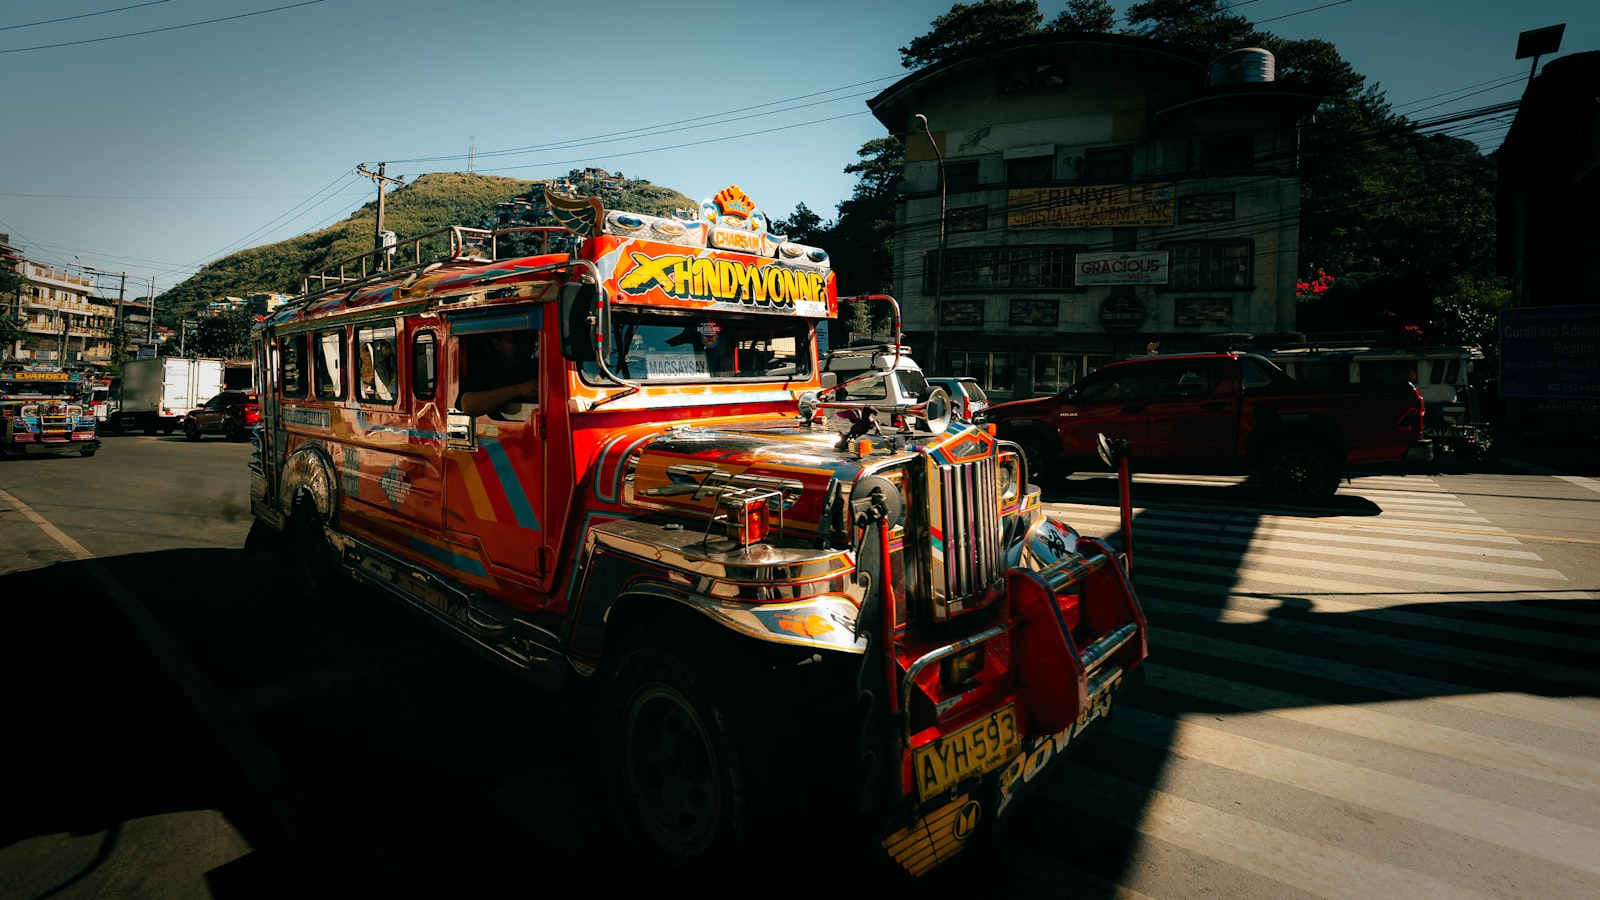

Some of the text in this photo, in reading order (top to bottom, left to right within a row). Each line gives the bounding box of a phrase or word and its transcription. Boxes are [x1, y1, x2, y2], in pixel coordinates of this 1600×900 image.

[1081, 259, 1161, 274] GRACIOUS
[1503, 324, 1558, 338] Cordillera
[1553, 341, 1595, 357] Region
[649, 360, 706, 376] MAGSAYSAY
